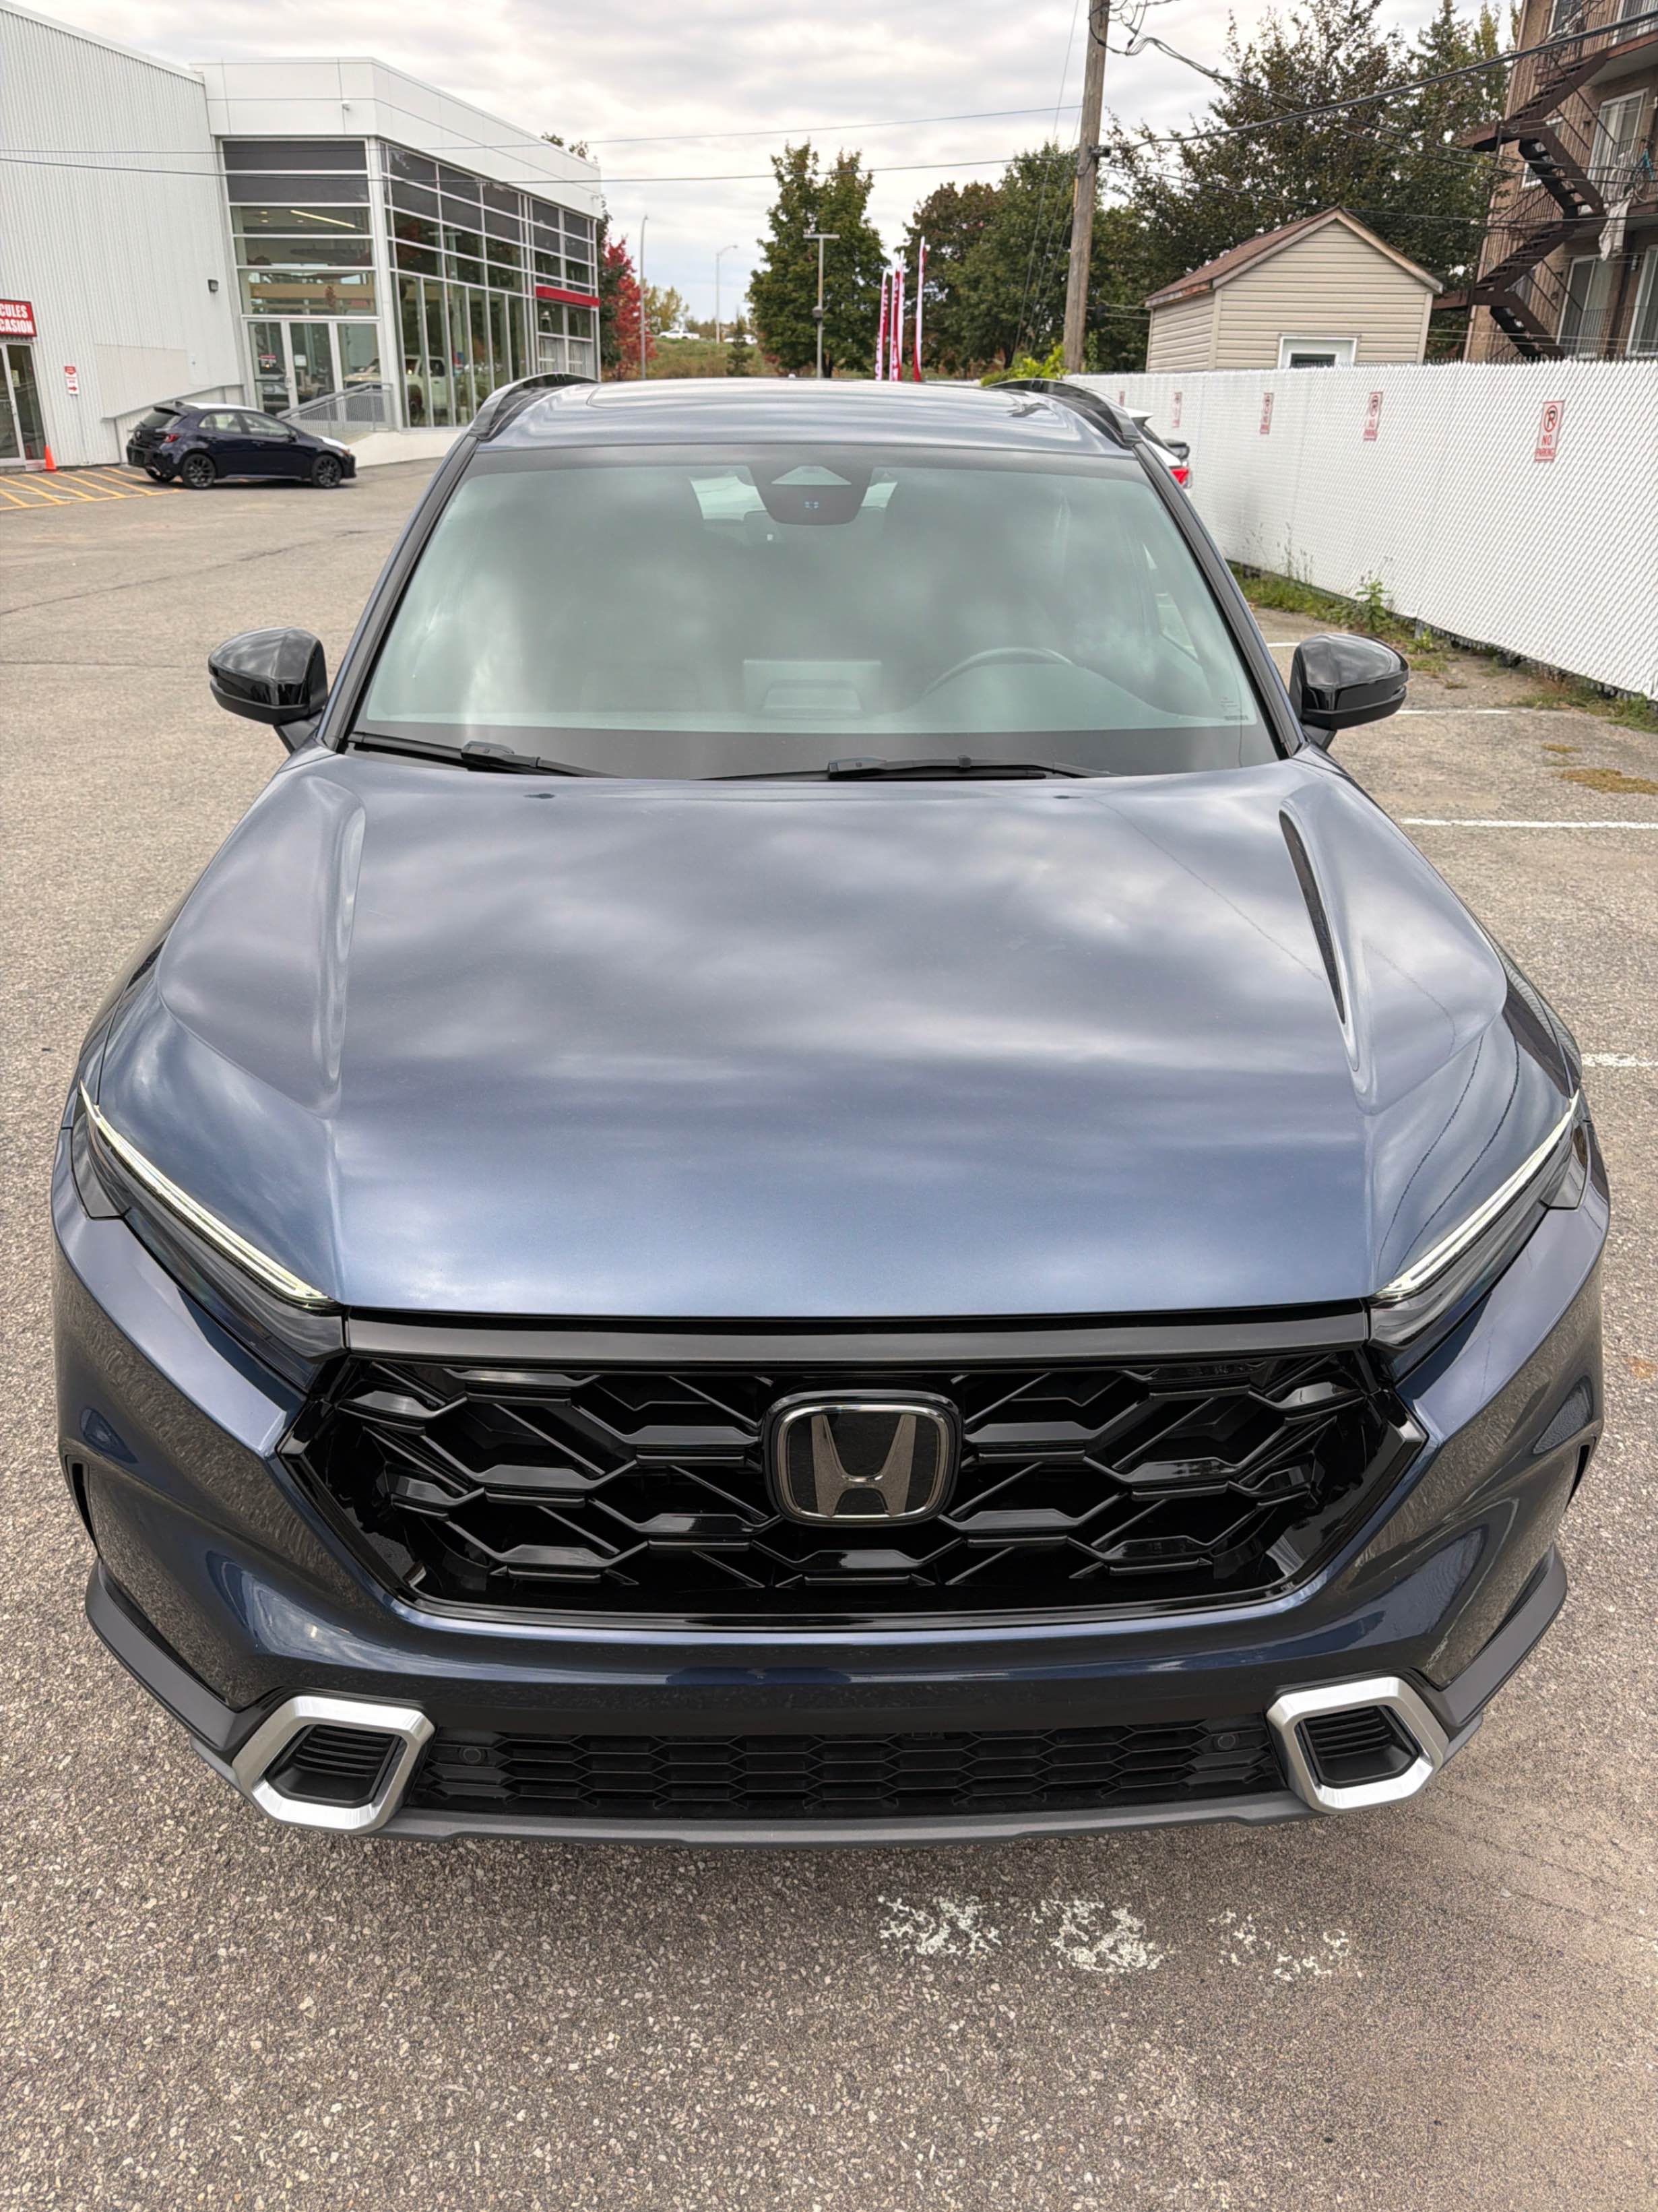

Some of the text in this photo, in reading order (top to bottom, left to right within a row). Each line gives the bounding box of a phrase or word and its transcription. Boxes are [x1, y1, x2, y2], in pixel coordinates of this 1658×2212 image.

[0, 303, 28, 319] CULES
[0, 318, 34, 334] CASION
[1541, 435, 1552, 445] NO
